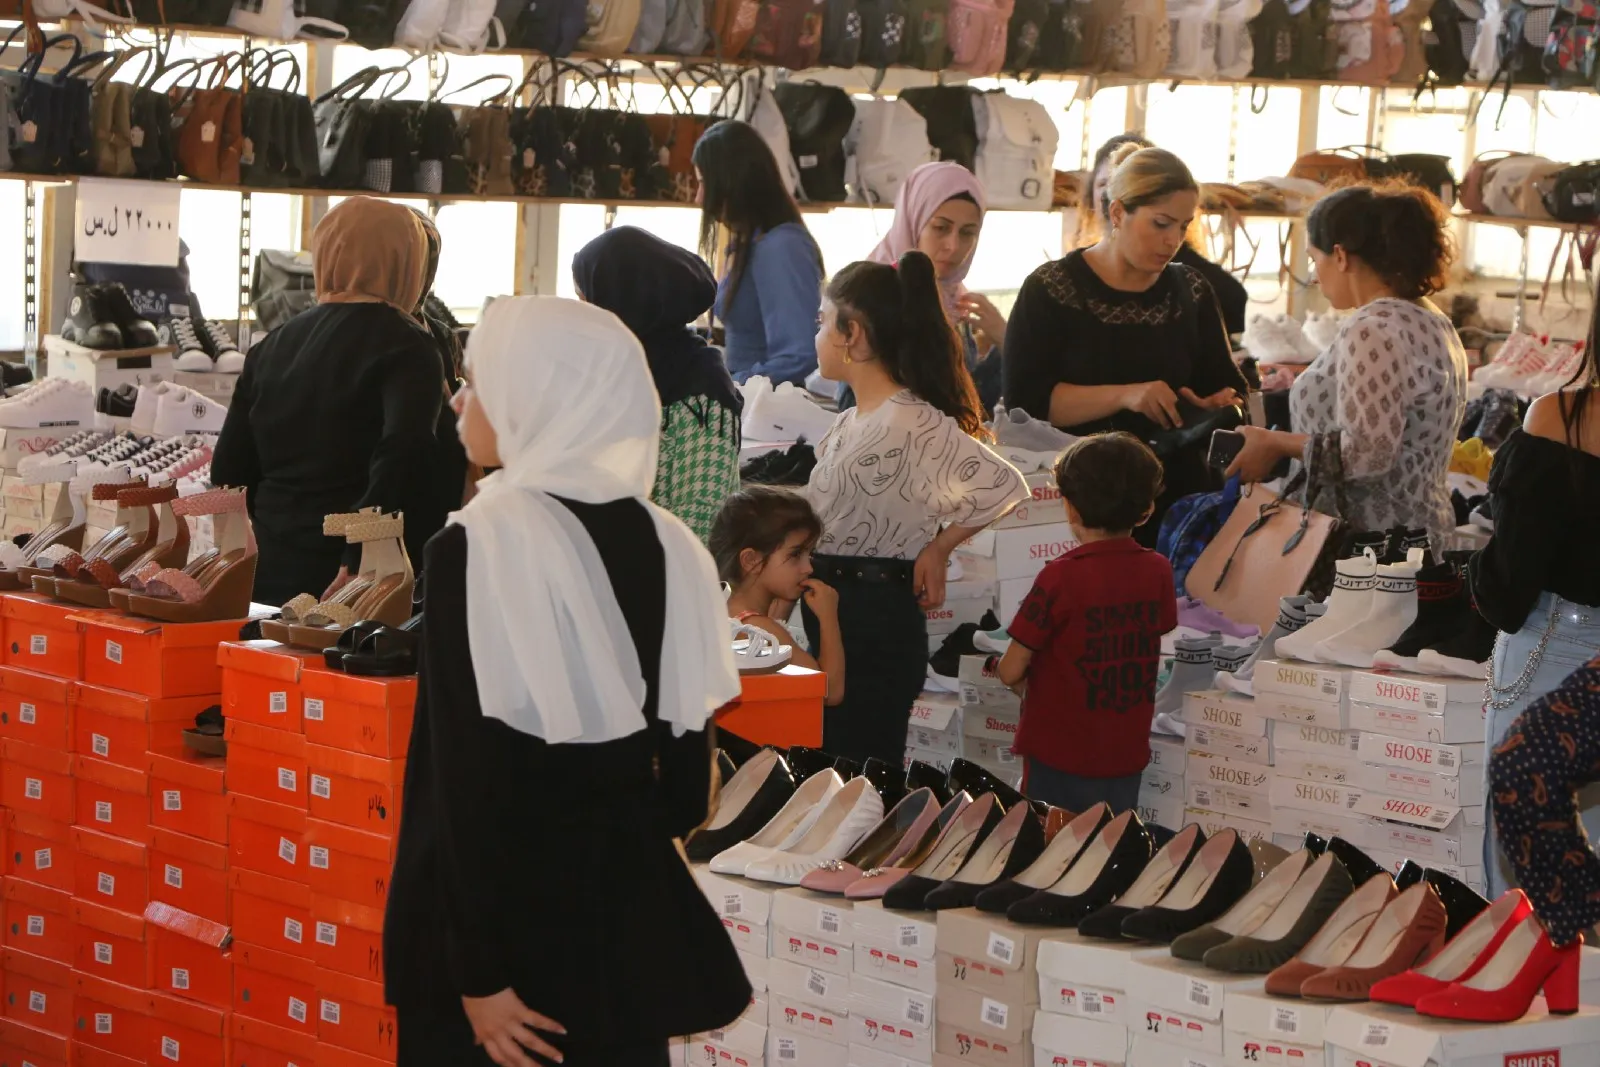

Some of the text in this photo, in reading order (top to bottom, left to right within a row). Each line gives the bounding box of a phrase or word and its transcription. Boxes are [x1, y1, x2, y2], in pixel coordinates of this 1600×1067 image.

[1032, 487, 1062, 501] Sho
[1276, 667, 1318, 688] SHOSE
[1375, 681, 1420, 703] SHOSE
[1202, 706, 1242, 728] SHOSE
[1299, 724, 1346, 747] SHOSE
[1385, 742, 1433, 764] SHOSE
[1209, 765, 1250, 787] SHOSE
[1294, 783, 1340, 806] SHOSE
[1382, 799, 1433, 818] SHOSE
